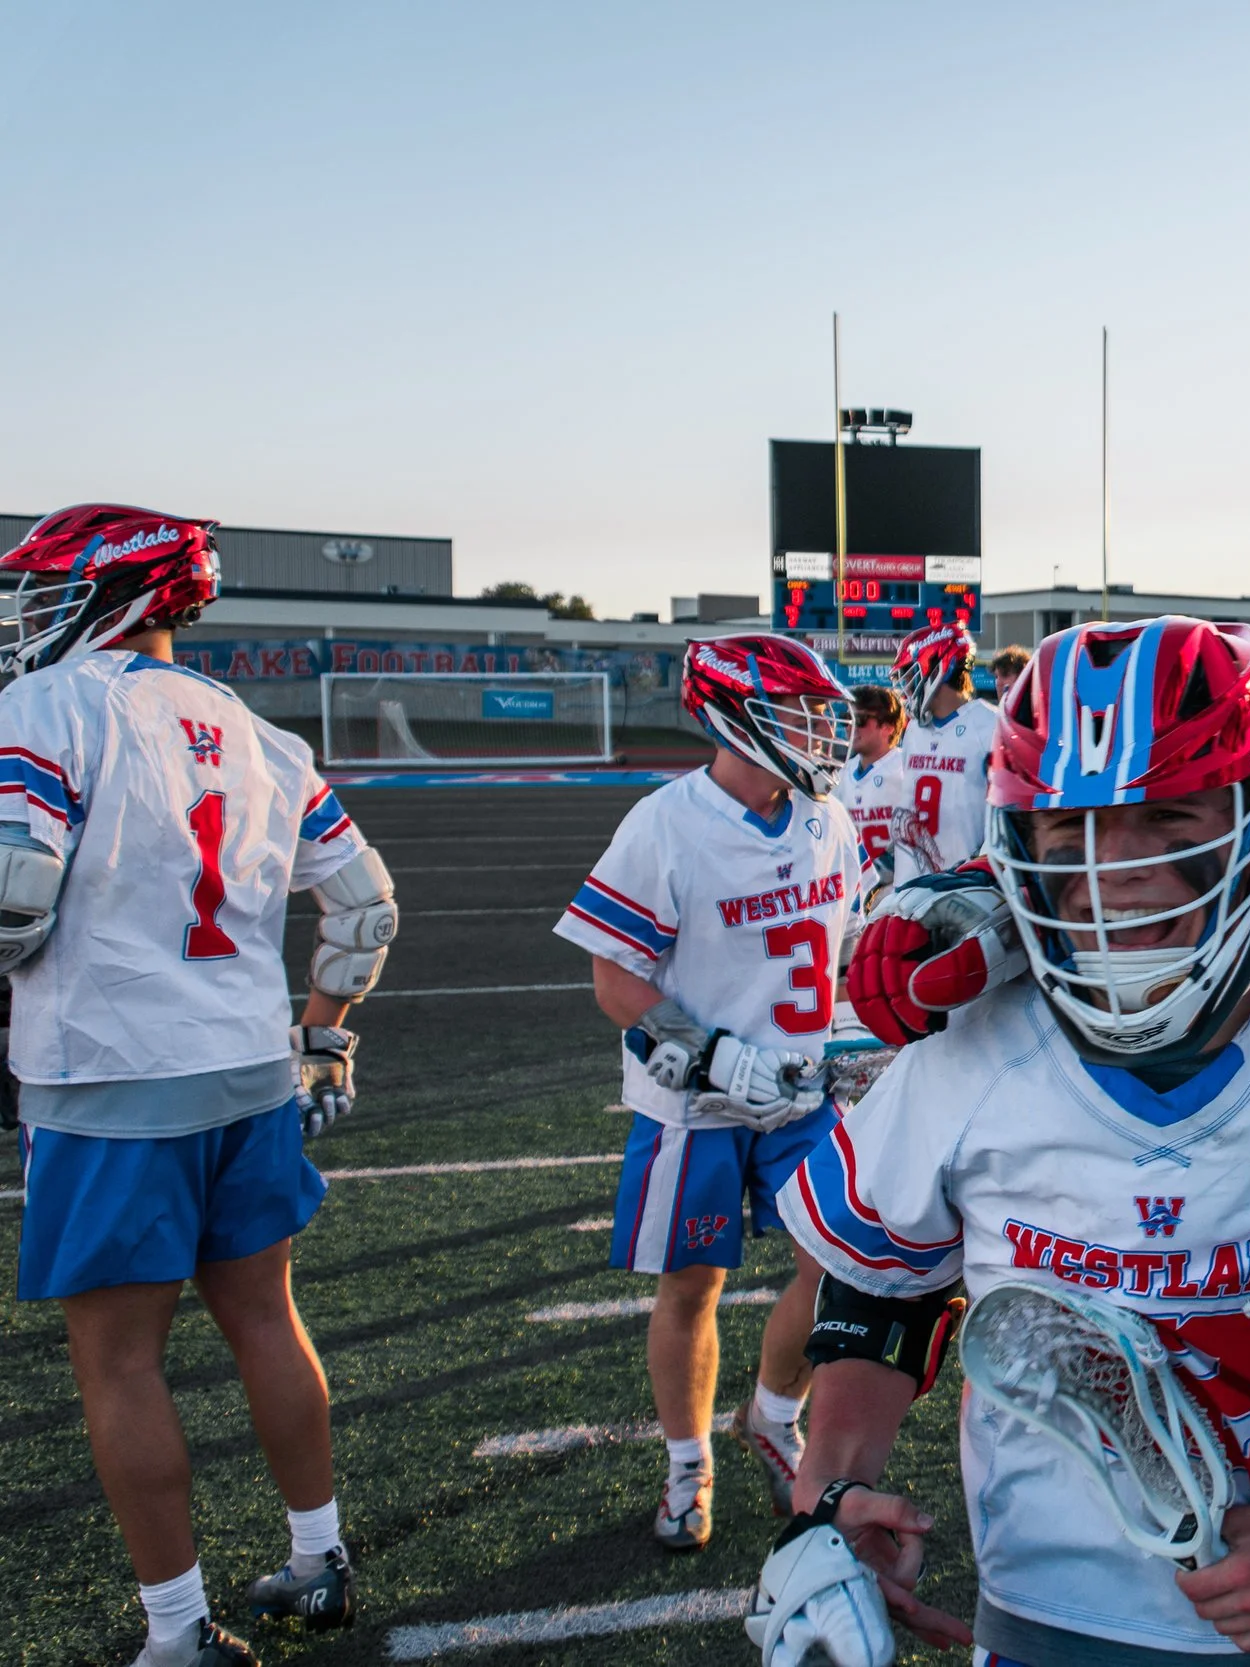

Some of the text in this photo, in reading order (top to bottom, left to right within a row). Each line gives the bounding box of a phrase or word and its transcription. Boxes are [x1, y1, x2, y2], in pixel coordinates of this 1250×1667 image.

[94, 524, 180, 568] Westlake
[177, 717, 224, 769] W
[914, 775, 943, 838] 9
[182, 788, 240, 961] 1
[716, 871, 845, 928] WESTLAKE
[762, 916, 832, 1037] 3
[684, 1214, 729, 1250] W
[1133, 1195, 1186, 1240] W
